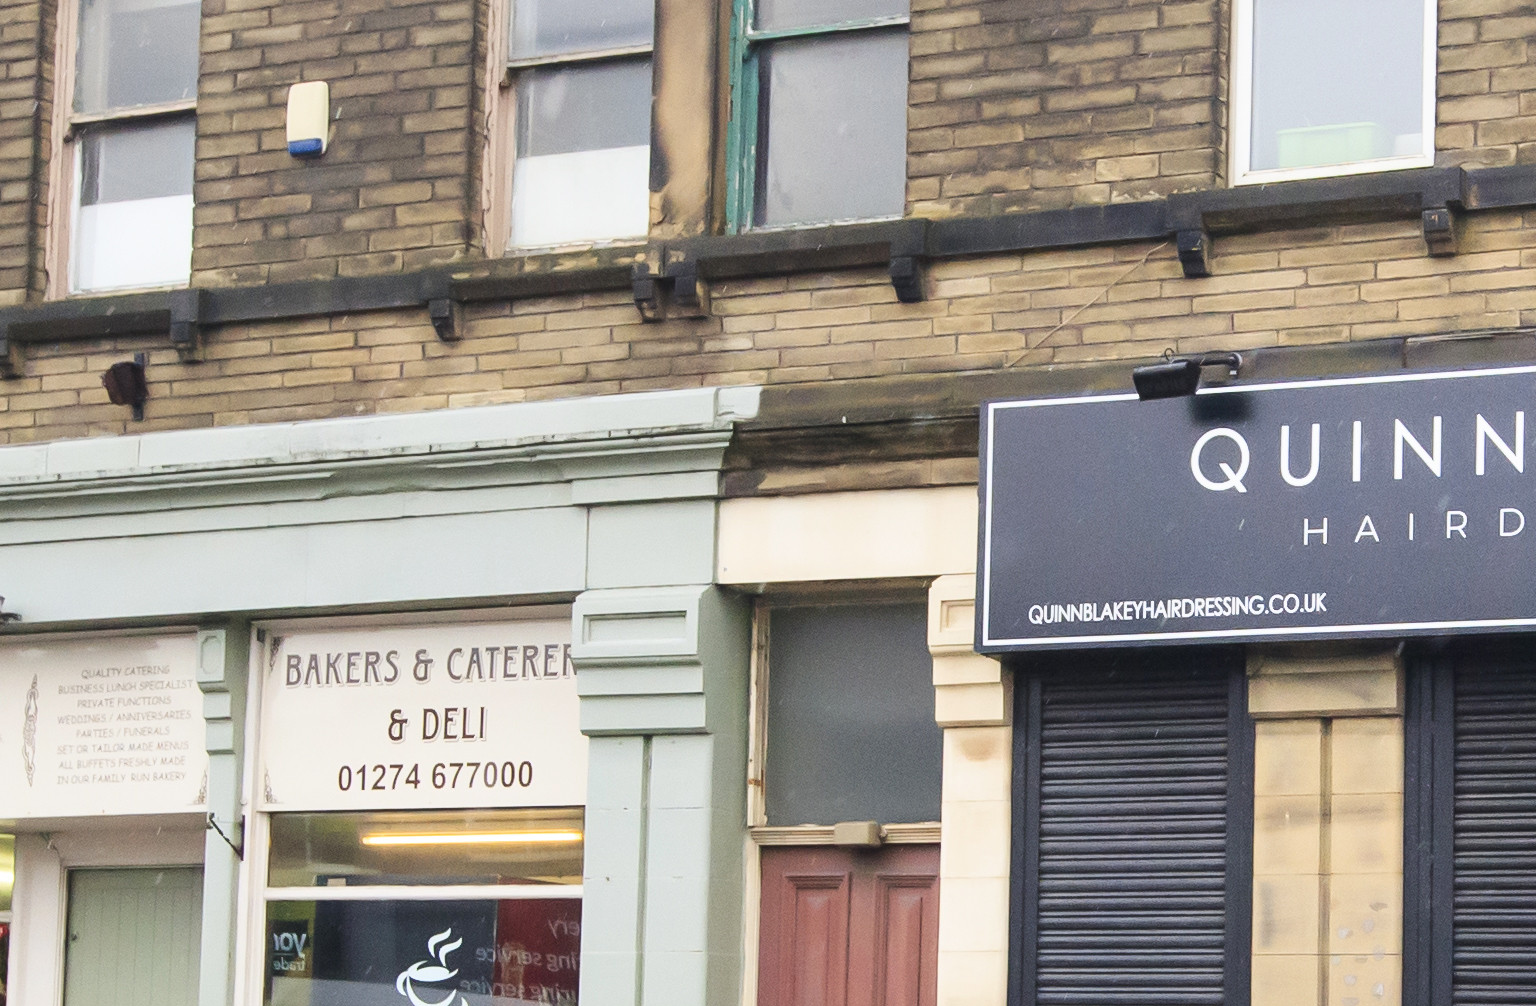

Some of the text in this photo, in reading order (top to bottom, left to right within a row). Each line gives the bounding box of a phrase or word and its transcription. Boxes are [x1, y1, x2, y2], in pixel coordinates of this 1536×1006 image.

[1190, 410, 1525, 493] QUINN
[1028, 592, 1327, 625] QUINNBLAKEYHAIRDRESSING.CO.UK
[81, 665, 170, 679] QUALITY CATERING
[285, 650, 400, 687] BAKERS
[412, 649, 434, 682] &
[58, 680, 193, 695] BUSINESS LUNCH SPECIALIST
[77, 696, 172, 708] PRIVATE FUNCTIONS
[57, 713, 106, 725] WEDDINGS
[116, 710, 192, 721] ANNIVERSARIES
[388, 706, 486, 742] & DELI
[76, 728, 114, 738] PARTIES
[124, 726, 170, 737] FUNERALS
[92, 743, 125, 753] TAILOR
[129, 742, 154, 751] MADE
[157, 741, 189, 751] MENUS
[59, 755, 186, 769] ALL BUFFETS FRESHLY MADE
[57, 770, 186, 785] IN OUR FAMILY RUN BAKERY
[338, 760, 533, 792] 01274 677000
